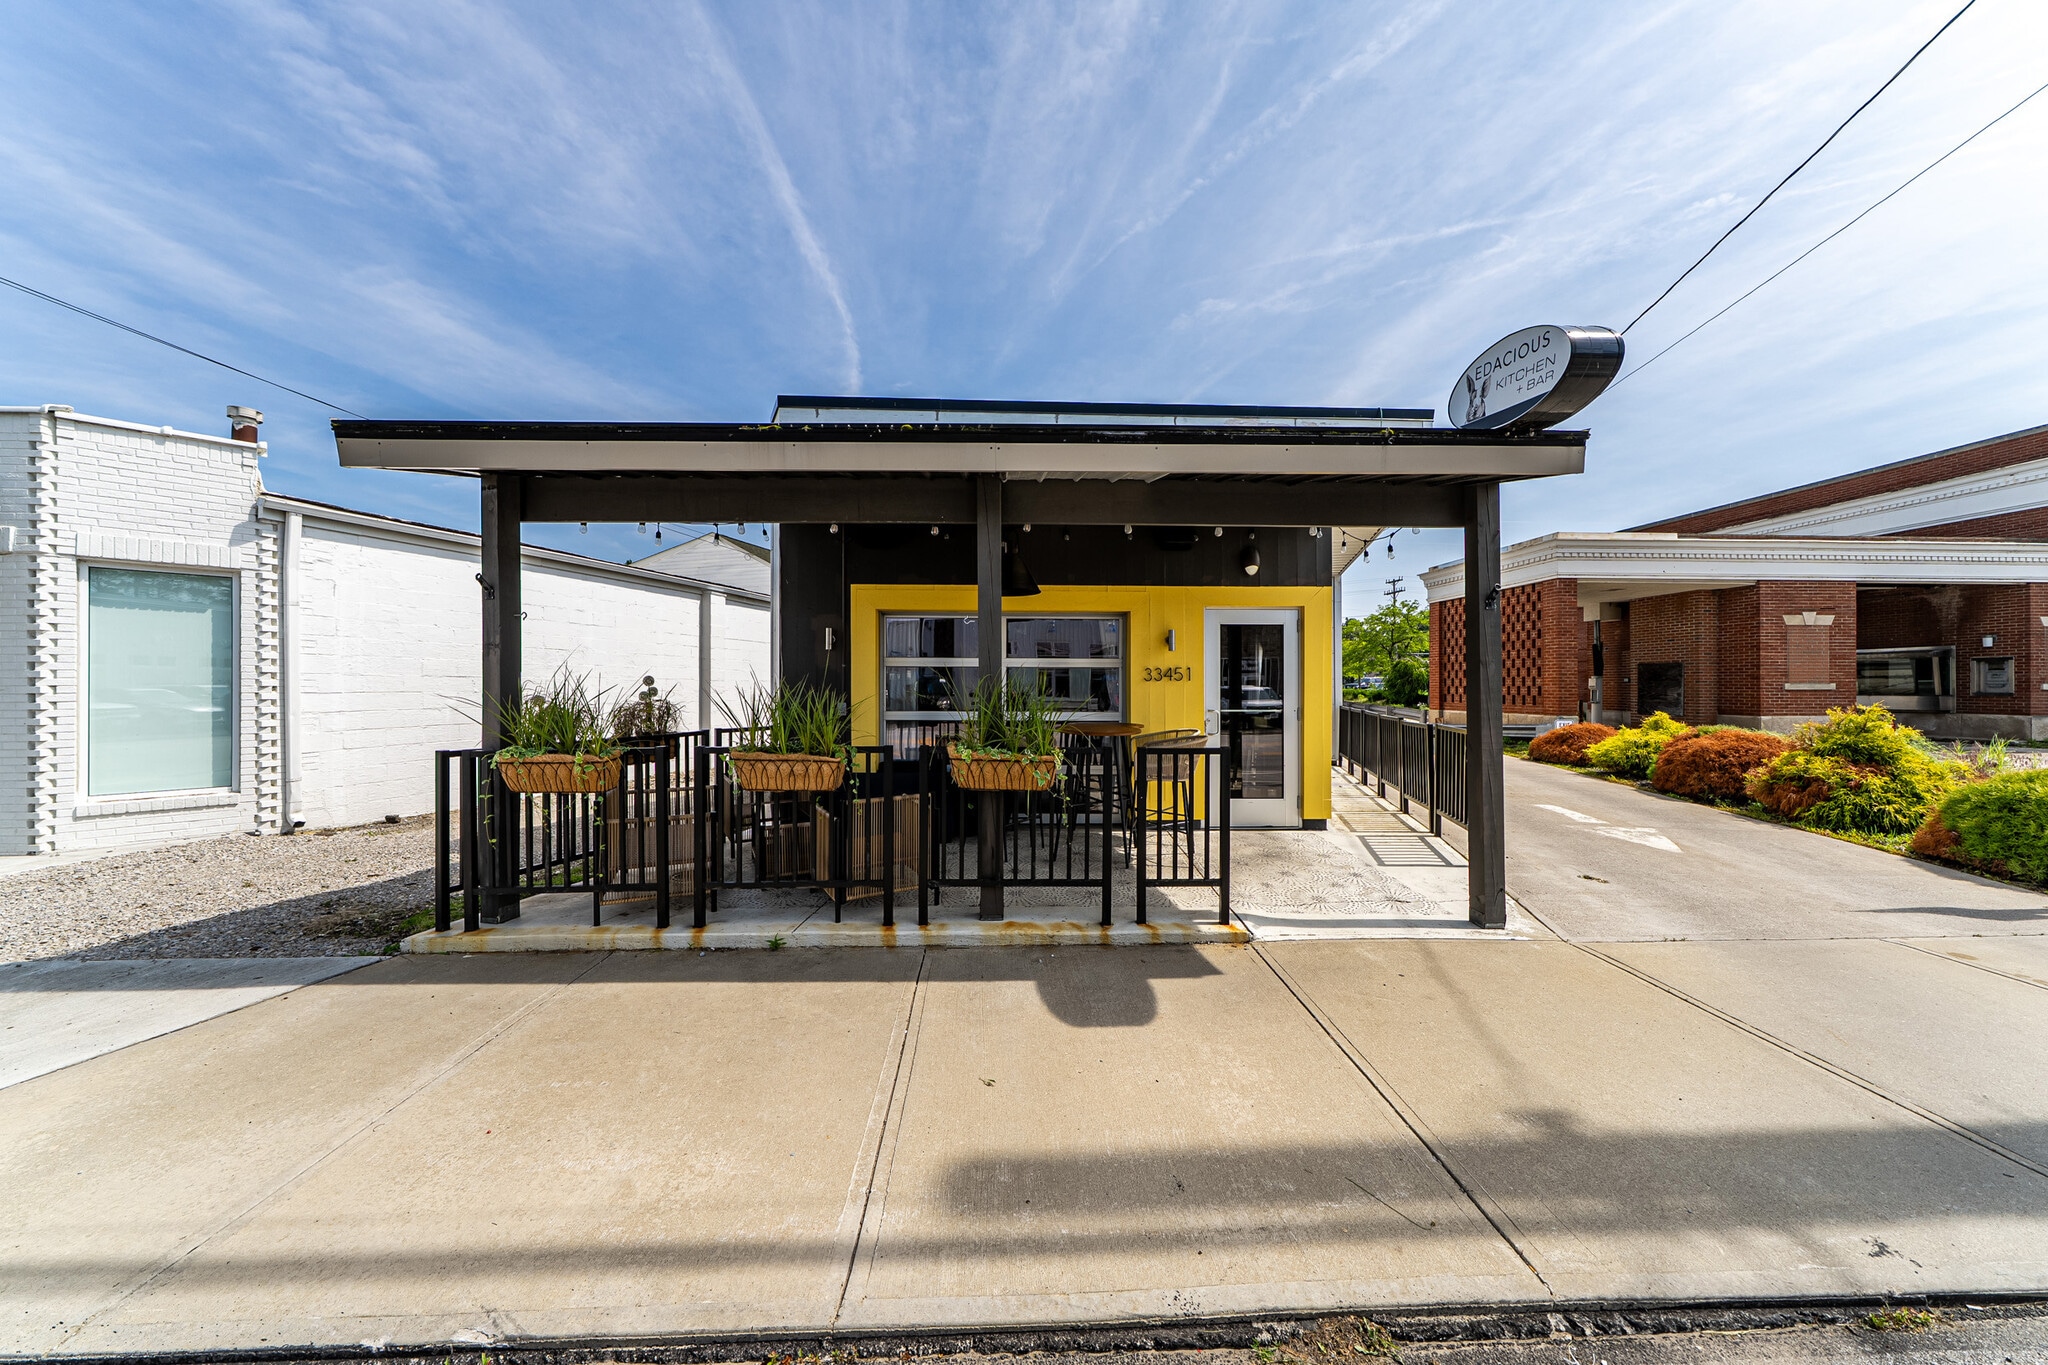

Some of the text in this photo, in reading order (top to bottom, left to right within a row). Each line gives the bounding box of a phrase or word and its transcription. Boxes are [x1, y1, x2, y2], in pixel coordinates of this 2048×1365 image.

[1475, 330, 1551, 381] EDACIOUS
[1496, 353, 1556, 391] KITCHEN
[1526, 369, 1555, 391] BAR
[1143, 666, 1191, 682] 33451
